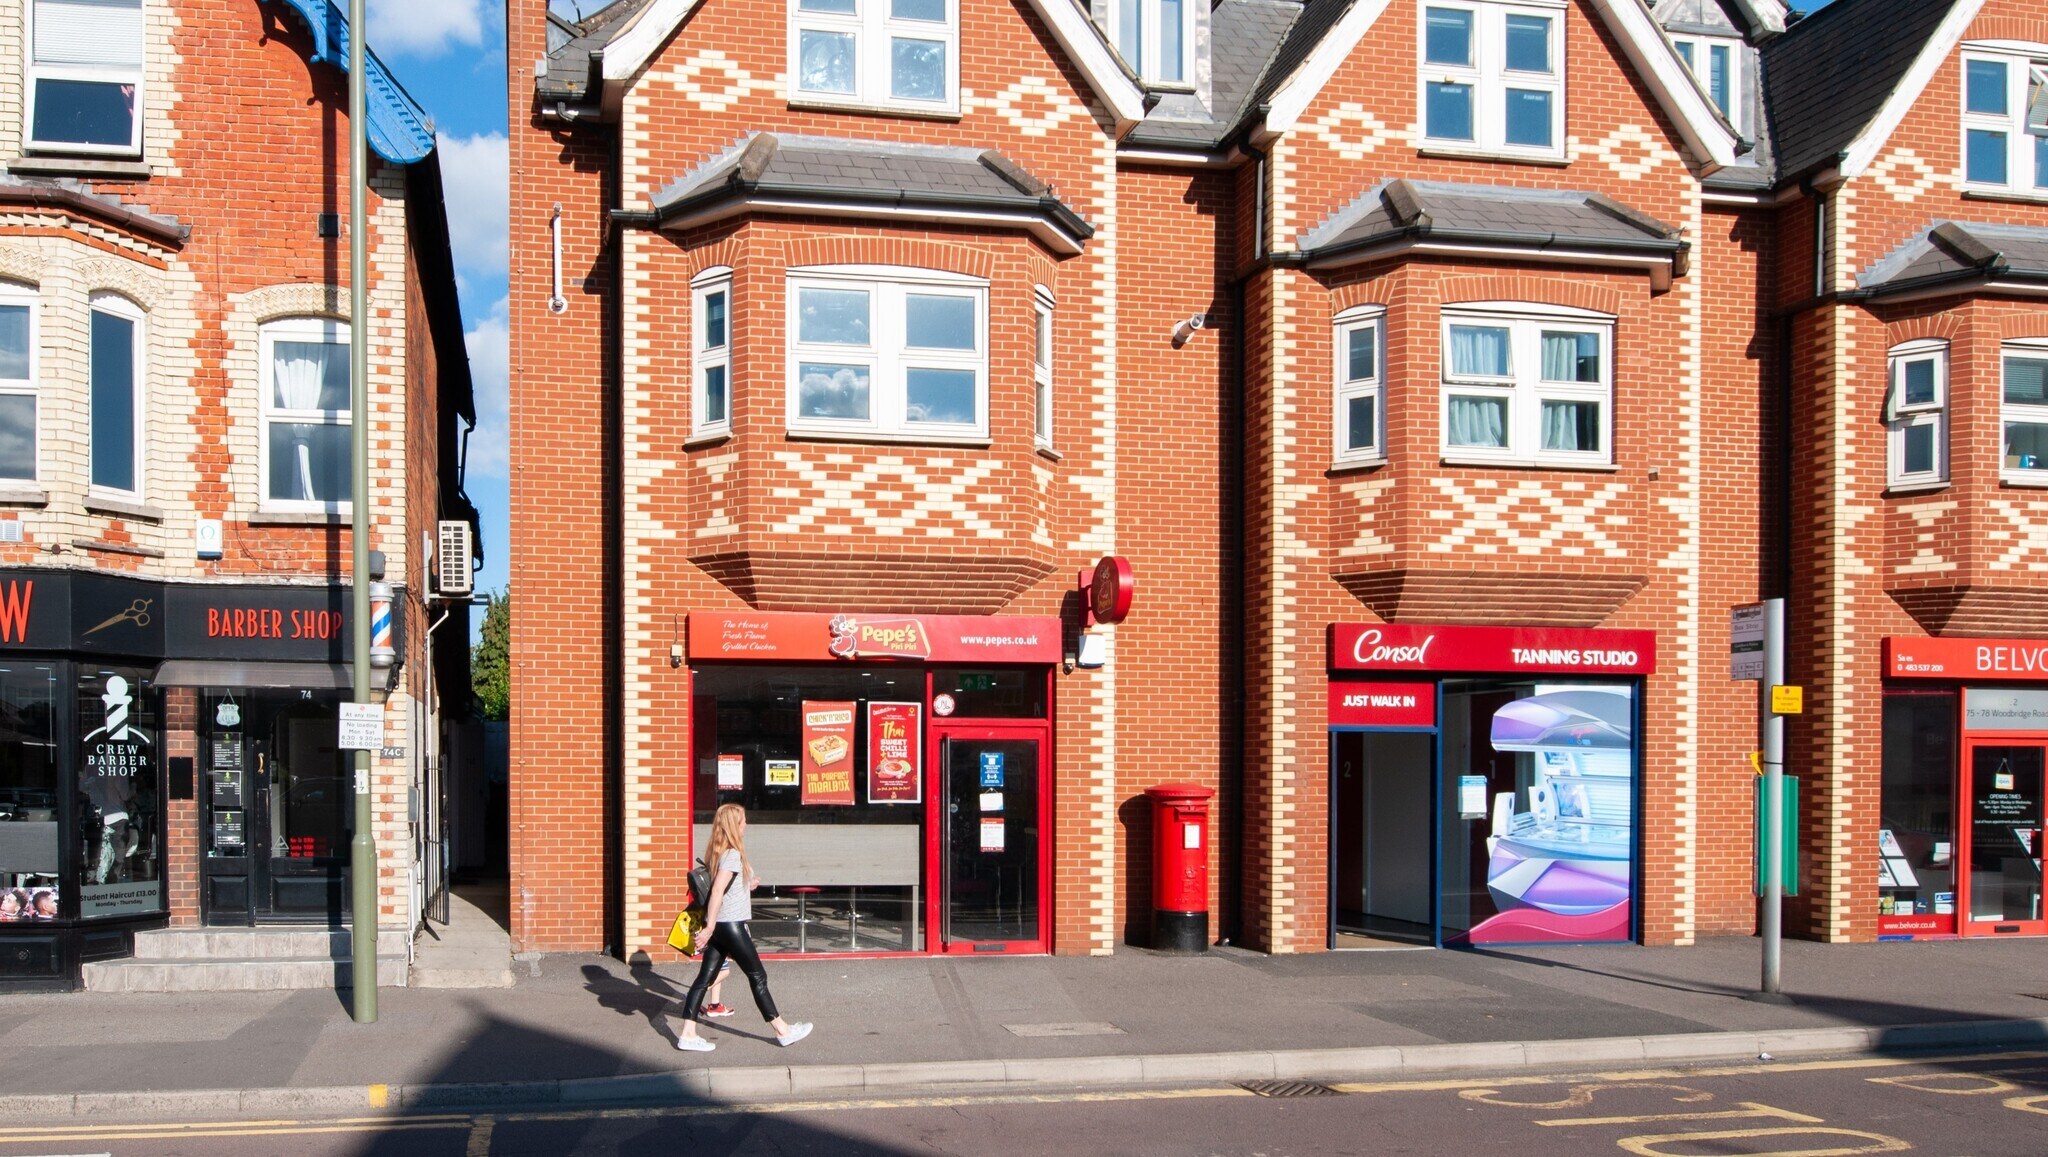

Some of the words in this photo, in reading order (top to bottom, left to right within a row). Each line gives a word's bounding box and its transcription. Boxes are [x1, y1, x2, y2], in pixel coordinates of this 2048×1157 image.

[208, 608, 282, 638] BARBER
[291, 610, 343, 639] SHOP
[722, 620, 736, 628] The
[738, 620, 759, 628] Home
[722, 630, 742, 639] Fresh
[862, 624, 917, 646] Pepe's
[960, 635, 1038, 646] www.pepes.co.uk
[1354, 629, 1435, 663] Consol
[1512, 649, 1581, 664] TANNING
[1582, 650, 1638, 666] STUDIO
[1897, 654, 1913, 662] Saes
[1931, 664, 1944, 672] 200
[301, 690, 312, 700] 74
[1343, 694, 1369, 706] JUST
[1370, 695, 1401, 707] WALK
[1403, 696, 1415, 707] IN
[1992, 710, 2031, 719] Woodbridge
[879, 721, 905, 739] Thai
[96, 744, 138, 754] CREW
[88, 755, 146, 766] BARBER
[98, 766, 137, 776] SHOP
[80, 893, 108, 902] Student
[110, 891, 135, 899] Haircut
[1884, 921, 1937, 929] www.belvoir.co.uk
